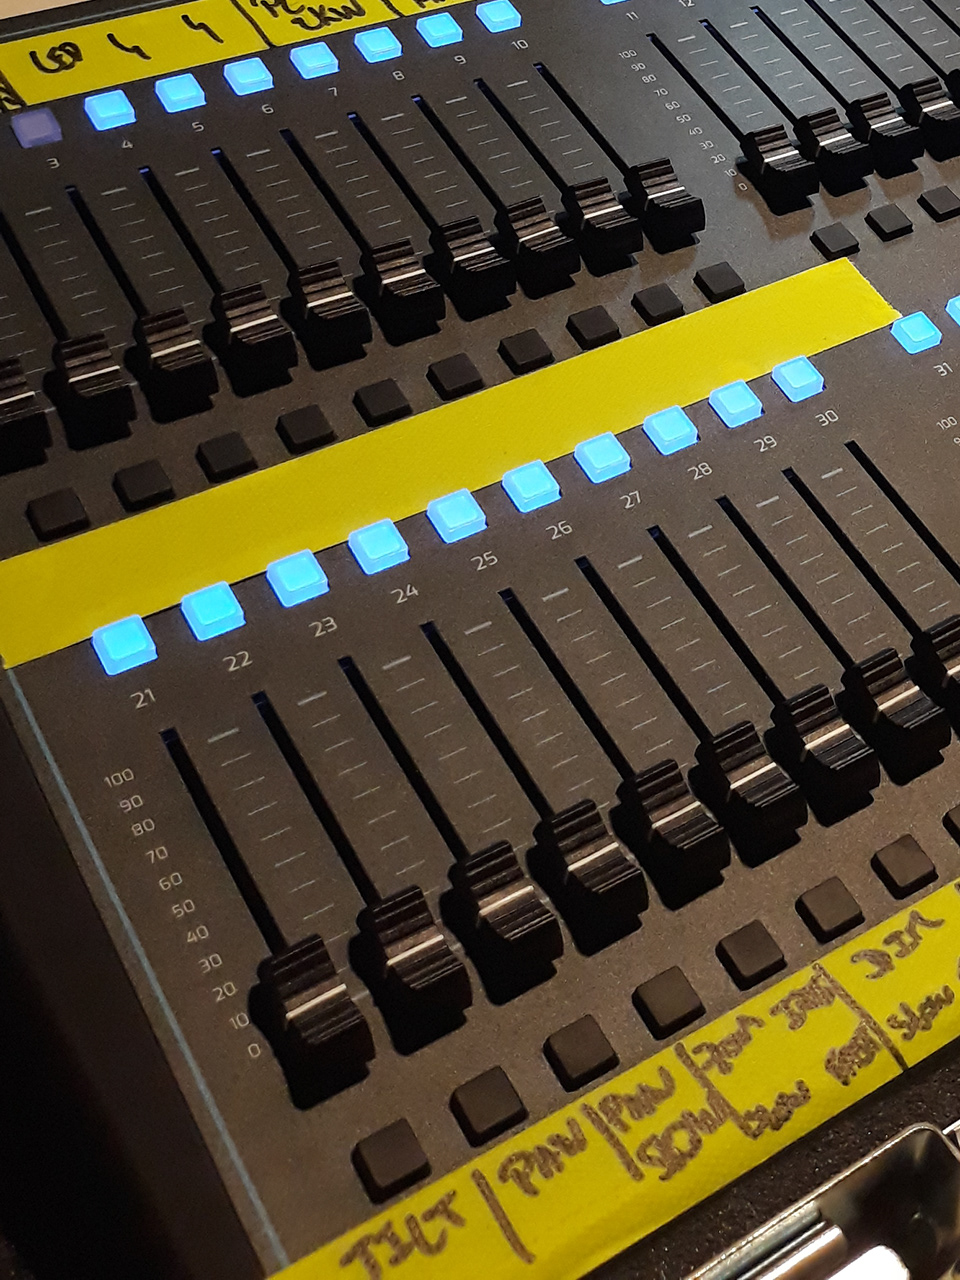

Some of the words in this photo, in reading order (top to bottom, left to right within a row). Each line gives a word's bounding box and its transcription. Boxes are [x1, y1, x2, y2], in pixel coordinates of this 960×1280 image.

[625, 10, 640, 21] 11
[618, 49, 638, 60] 100
[631, 61, 647, 73] 90
[641, 73, 657, 84] 80
[654, 87, 669, 98] 70
[46, 157, 61, 170] 3
[121, 139, 134, 151] 4
[191, 120, 205, 133] 5
[260, 103, 275, 116] 6
[327, 87, 340, 97] 7
[392, 70, 405, 82] 8
[454, 54, 467, 66] 9
[511, 38, 530, 51] 10
[665, 100, 681, 112] 60
[676, 113, 692, 125] 50
[688, 126, 704, 137] 40
[699, 139, 715, 151] 30
[711, 153, 727, 165] 20
[724, 167, 738, 179] 10
[738, 182, 749, 192] 0
[932, 361, 955, 378] 31
[936, 415, 959, 431] 100
[129, 688, 157, 710] 21
[222, 650, 254, 673] 22
[308, 616, 339, 638] 23
[389, 583, 420, 605] 24
[470, 551, 499, 572] 25
[545, 520, 574, 541] 26
[619, 489, 643, 510] 27
[687, 462, 714, 481] 28
[753, 435, 778, 453] 29
[815, 409, 840, 428] 30
[103, 767, 135, 789] 100
[119, 794, 145, 813] 90
[131, 817, 156, 837] 80
[145, 845, 169, 864] 70
[158, 871, 184, 892] 60
[171, 898, 196, 919] 50
[186, 924, 210, 944] 40
[198, 952, 223, 975] 30
[211, 980, 238, 1003] 20
[229, 1012, 251, 1031] 10
[247, 1042, 262, 1059] 0
[339, 1189, 467, 1280] TILT
